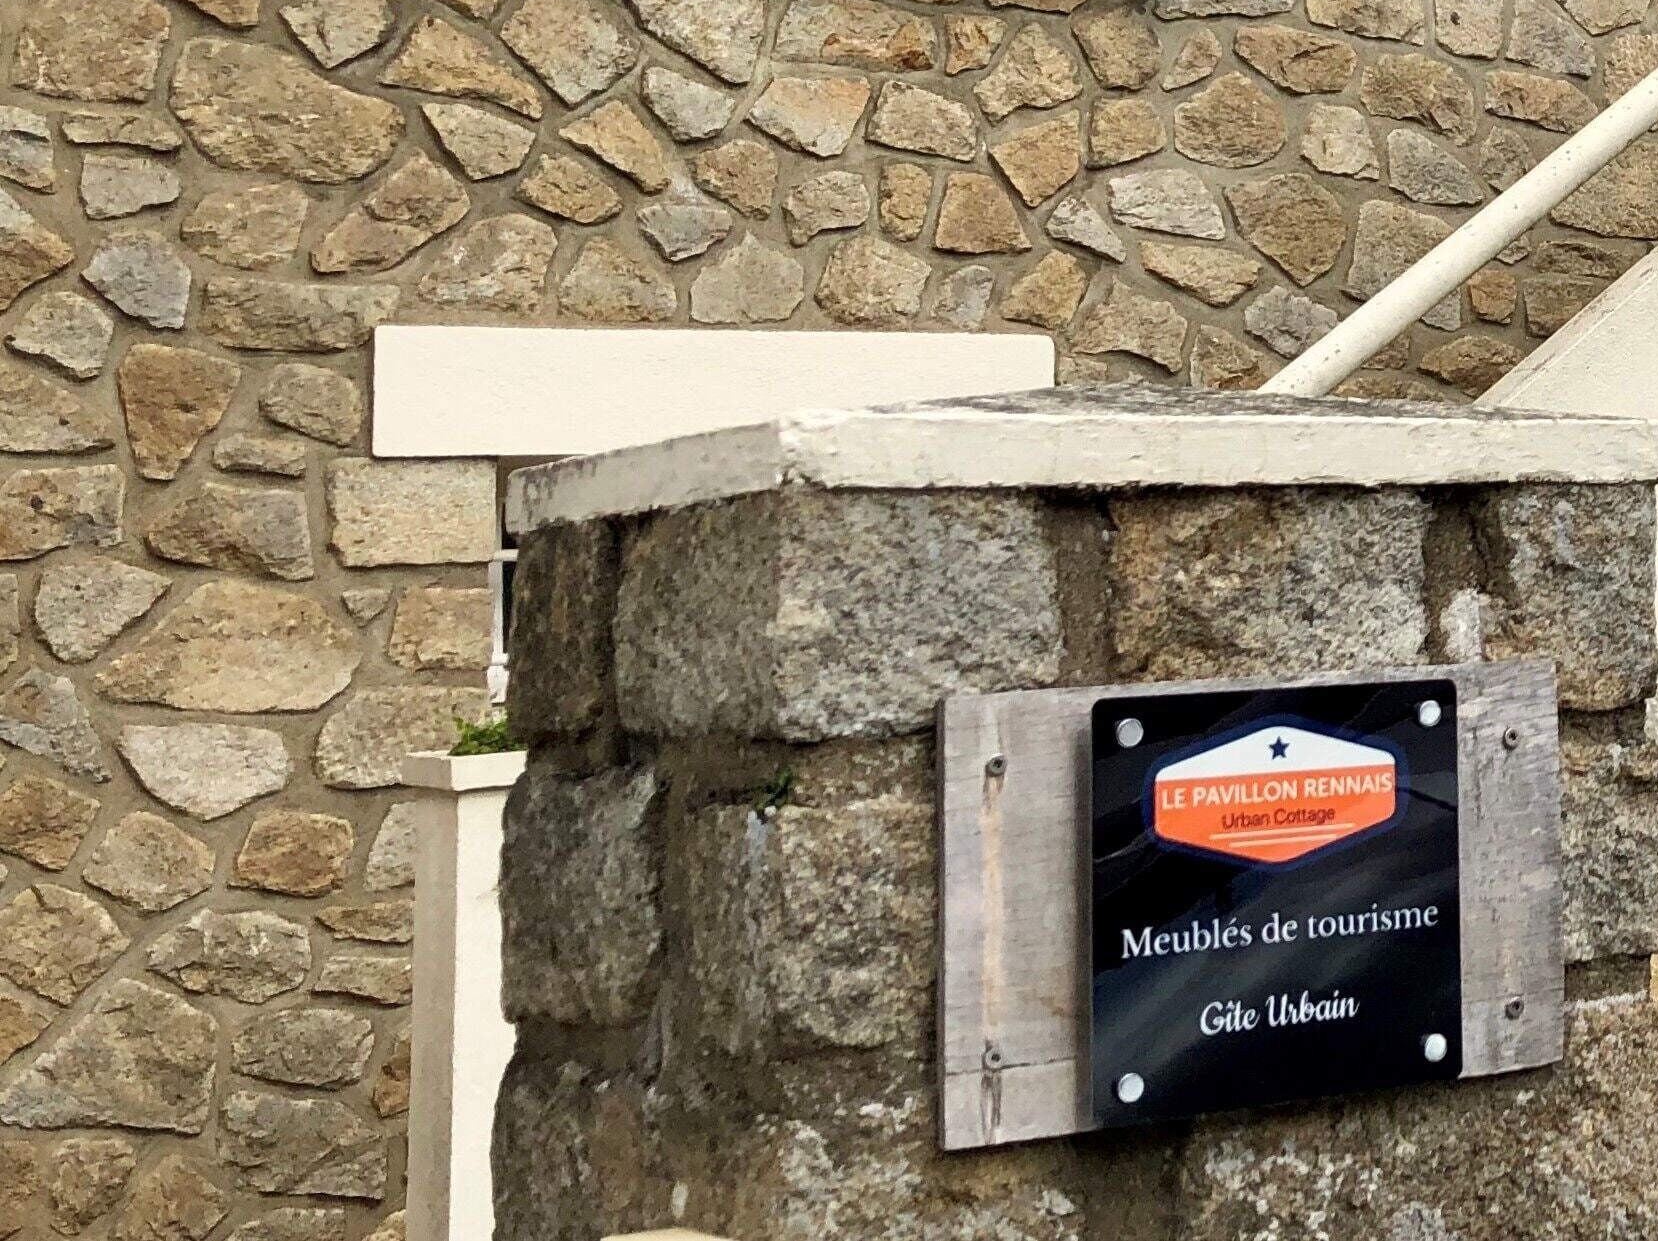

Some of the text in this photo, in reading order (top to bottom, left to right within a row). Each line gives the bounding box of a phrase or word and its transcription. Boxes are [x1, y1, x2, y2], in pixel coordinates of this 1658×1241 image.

[1161, 772, 1393, 810] LE PAVILLON RENNAIS
[1222, 807, 1335, 830] Urban Cottage
[1121, 902, 1439, 959] Meublés de tourisme
[1200, 990, 1360, 1036] Gîte Urbain
